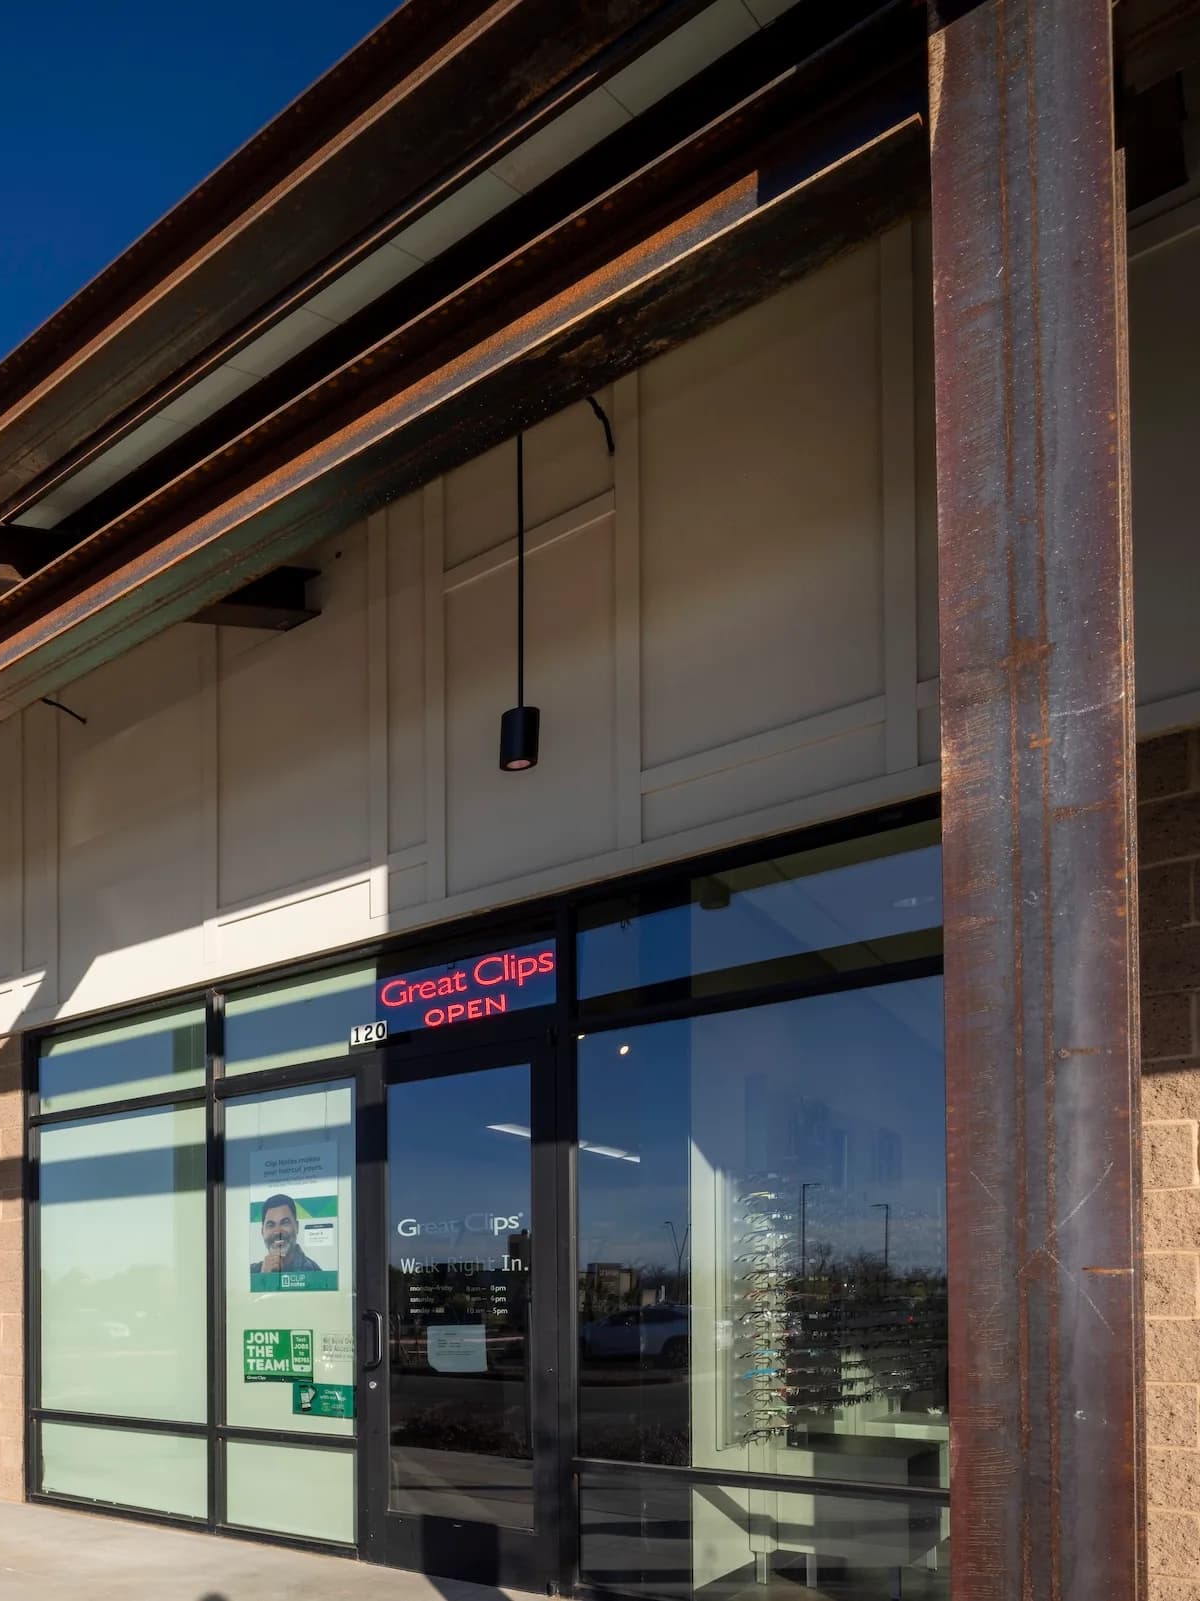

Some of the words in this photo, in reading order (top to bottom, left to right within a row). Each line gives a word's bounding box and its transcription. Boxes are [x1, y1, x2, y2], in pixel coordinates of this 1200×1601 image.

[381, 970, 468, 1008] Great
[473, 951, 555, 987] Clips
[423, 993, 506, 1028] OPEN
[354, 1022, 386, 1044] 120
[397, 1217, 461, 1237] Great
[464, 1212, 520, 1236] Clips
[400, 1256, 440, 1275] Walk
[447, 1255, 496, 1277] Right
[501, 1254, 529, 1272] In.
[246, 1331, 279, 1345] JOIN
[246, 1345, 273, 1358] THE
[246, 1358, 290, 1372] TEAM!
